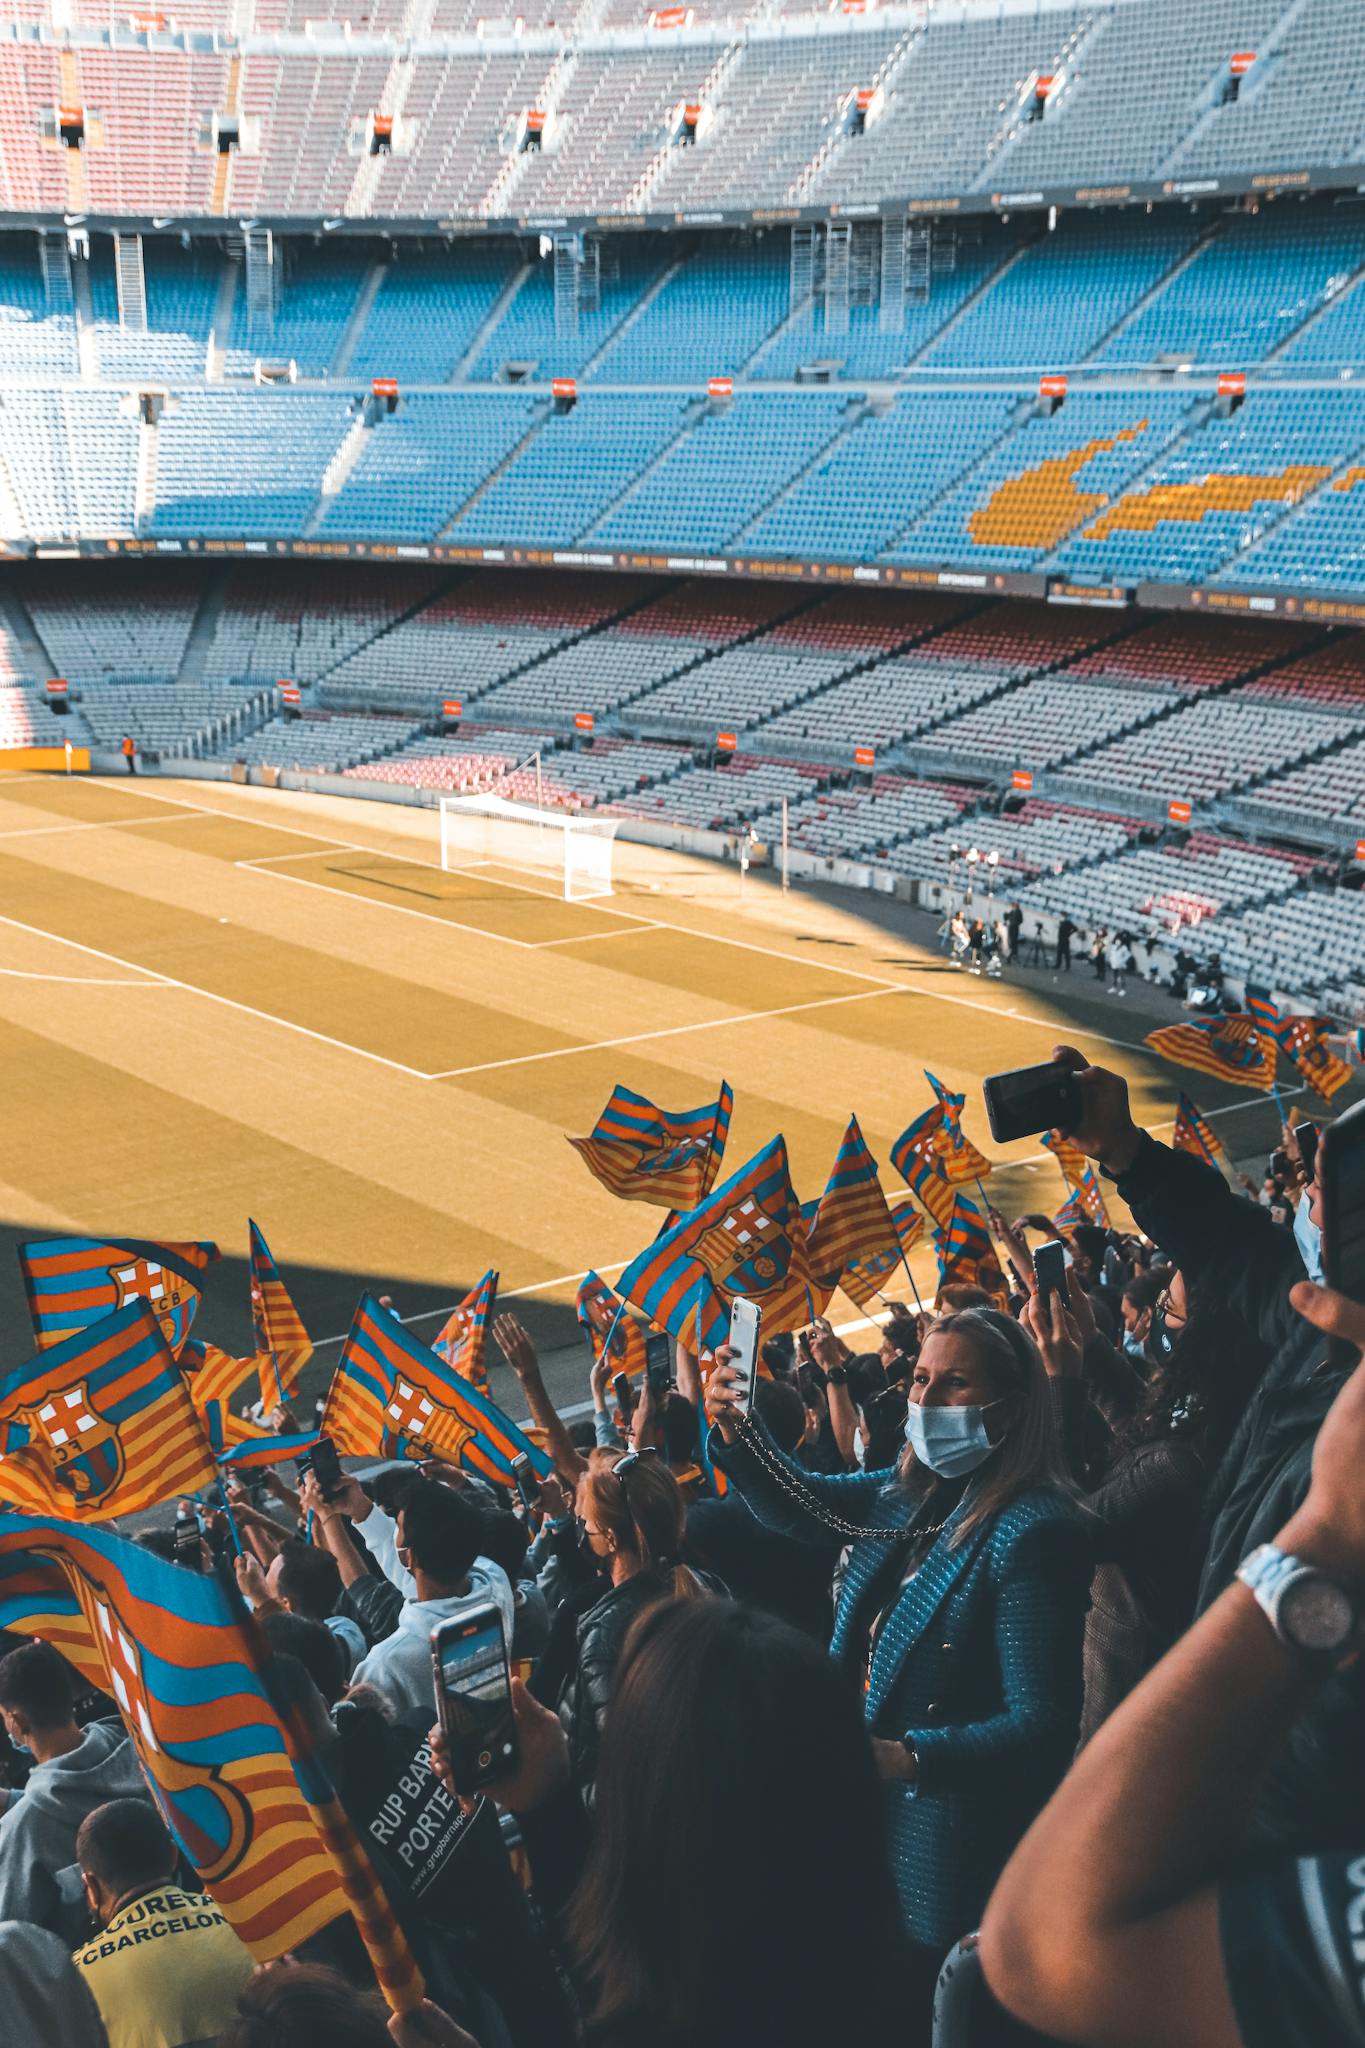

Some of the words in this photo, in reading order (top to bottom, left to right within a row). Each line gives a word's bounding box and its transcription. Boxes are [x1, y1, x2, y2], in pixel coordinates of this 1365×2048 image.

[150, 1292, 181, 1311] CB
[369, 1793, 407, 1845] RUP
[398, 1778, 455, 1868] PORTE
